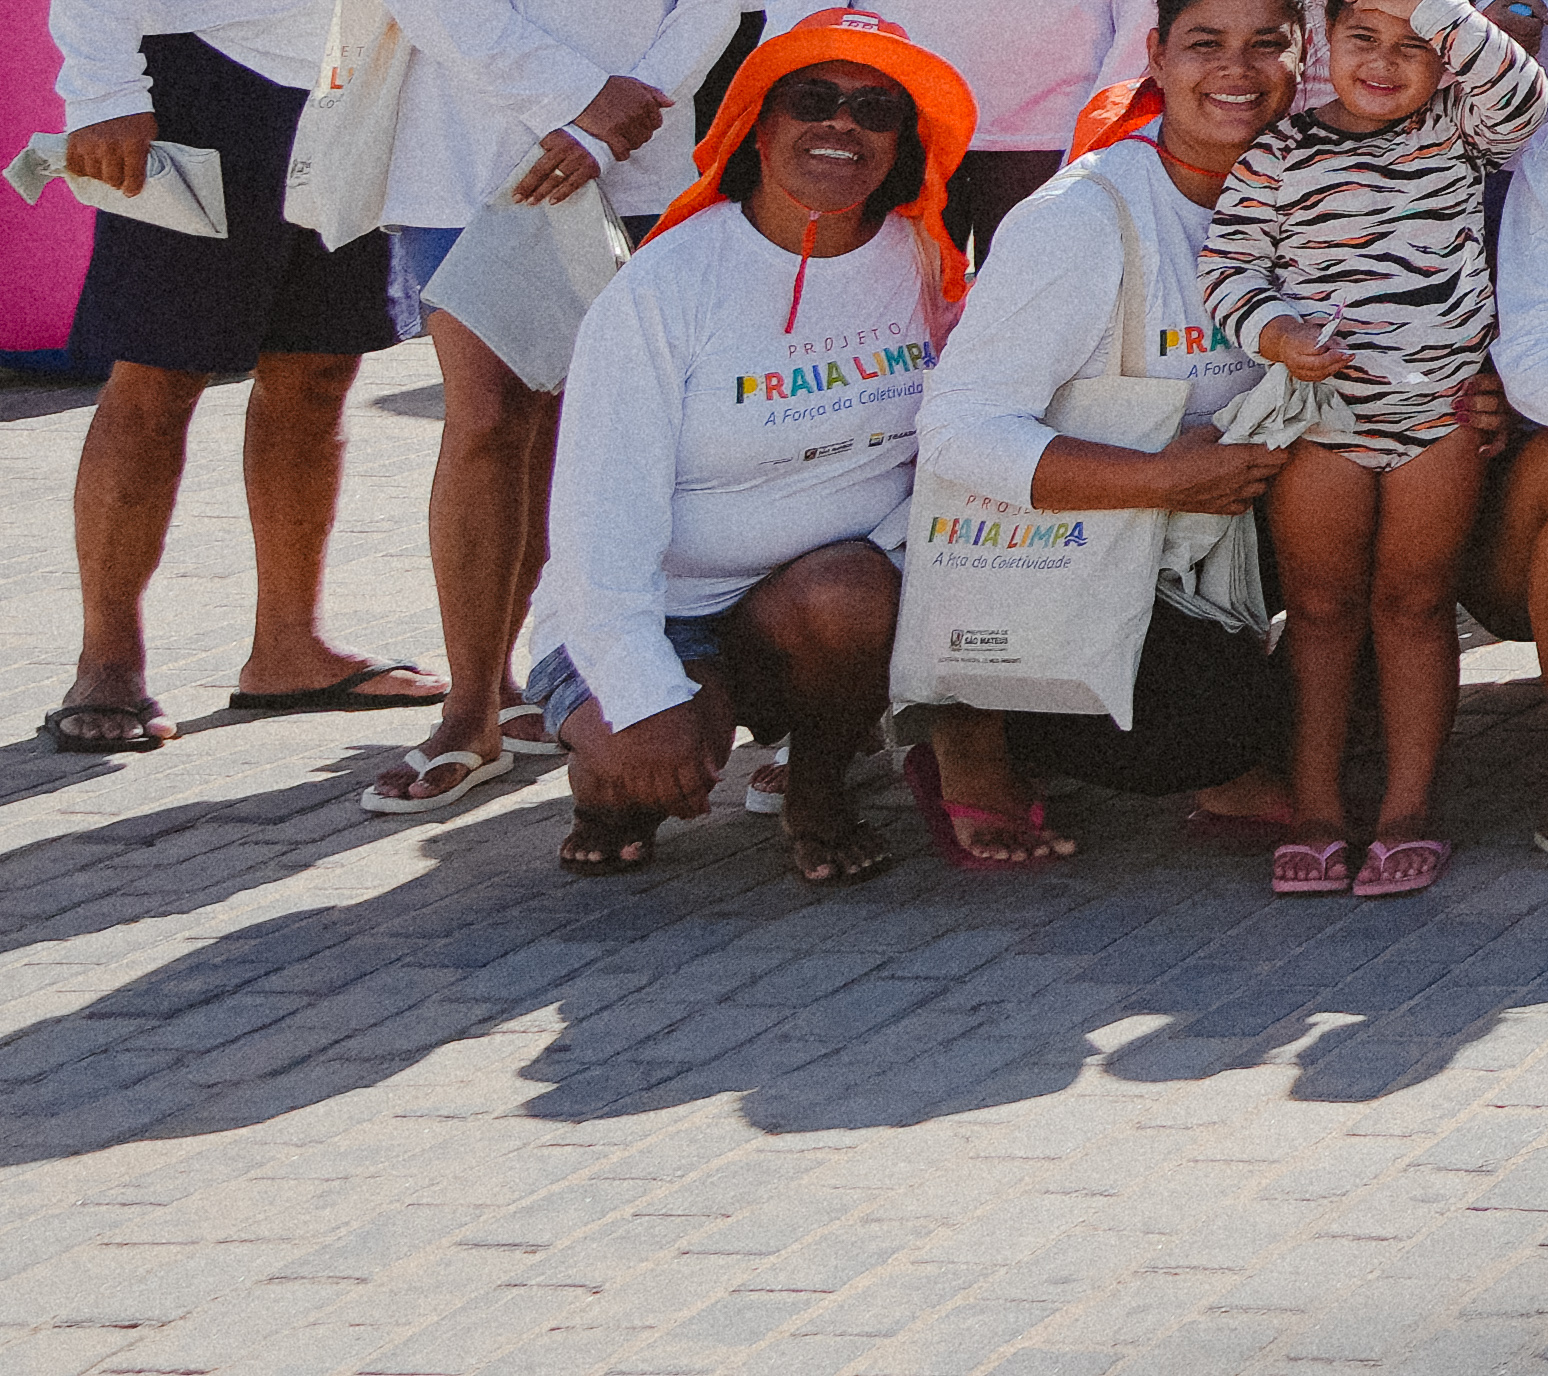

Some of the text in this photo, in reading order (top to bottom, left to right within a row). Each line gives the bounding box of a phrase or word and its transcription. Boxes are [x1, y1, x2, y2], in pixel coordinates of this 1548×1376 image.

[787, 321, 902, 359] PROJETO
[736, 340, 938, 405] PRAIA LIMPA
[782, 393, 854, 425] Força da
[1006, 521, 1088, 549] LIMPA
[991, 555, 1072, 569] Coletividade
